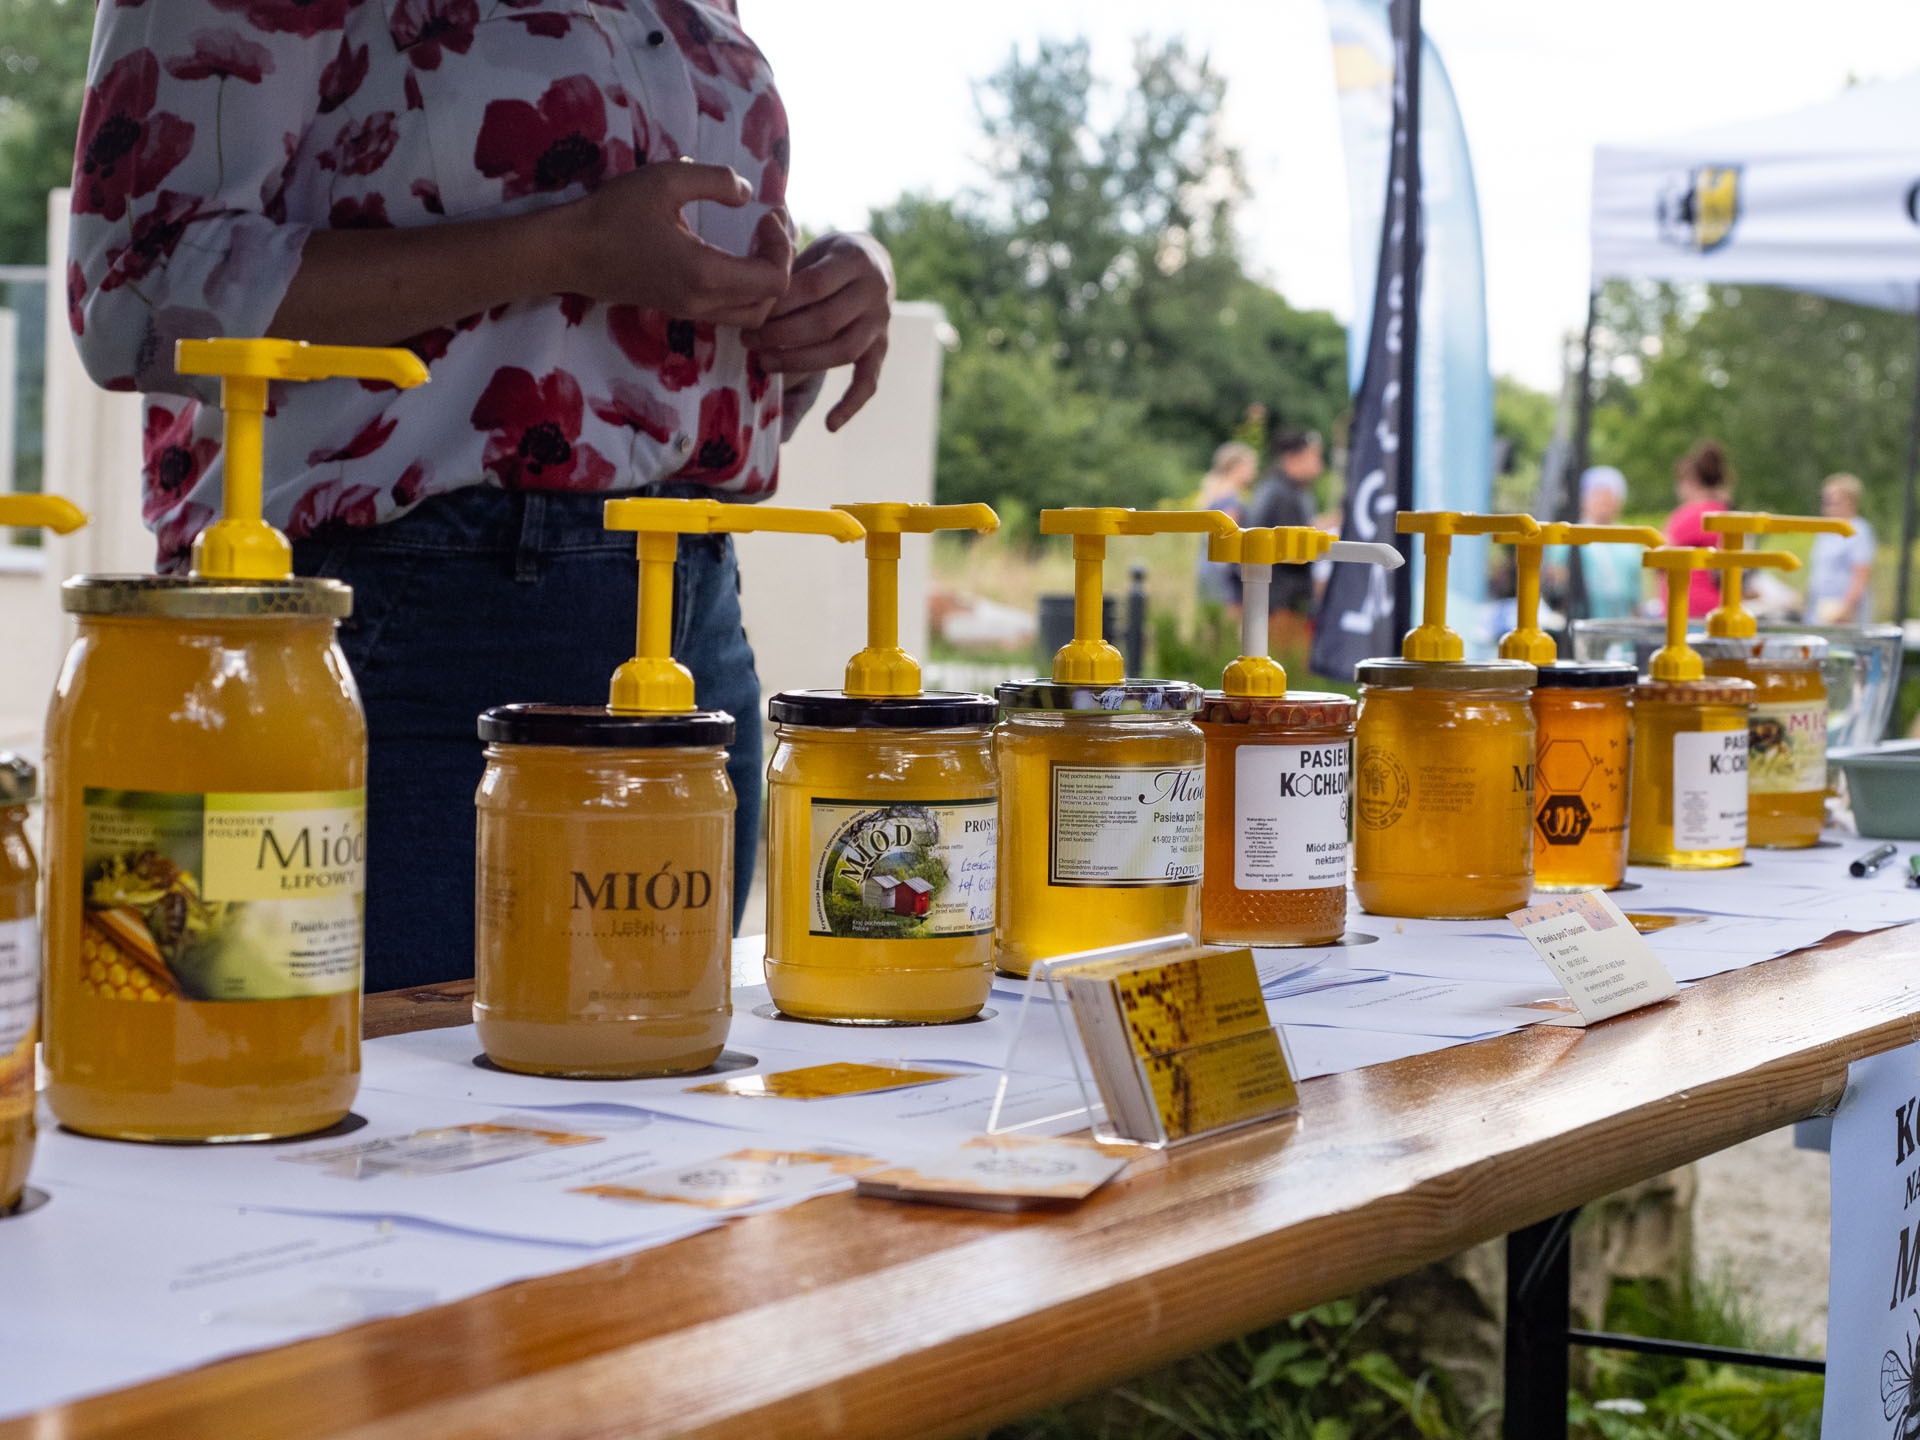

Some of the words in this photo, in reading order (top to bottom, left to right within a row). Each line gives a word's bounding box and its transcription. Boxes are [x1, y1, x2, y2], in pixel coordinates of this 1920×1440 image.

[1153, 811, 1184, 823] Pasieka
[1185, 811, 1196, 825] pod
[1152, 835, 1172, 844] 41-902
[1306, 843, 1327, 853] Miód
[840, 823, 913, 886] MIÓD
[1165, 861, 1201, 881] lipowy
[570, 860, 712, 911] MIÓD
[1536, 934, 1557, 945] Pasieka
[1556, 930, 1568, 942] pod
[1564, 925, 1587, 938] Topolami
